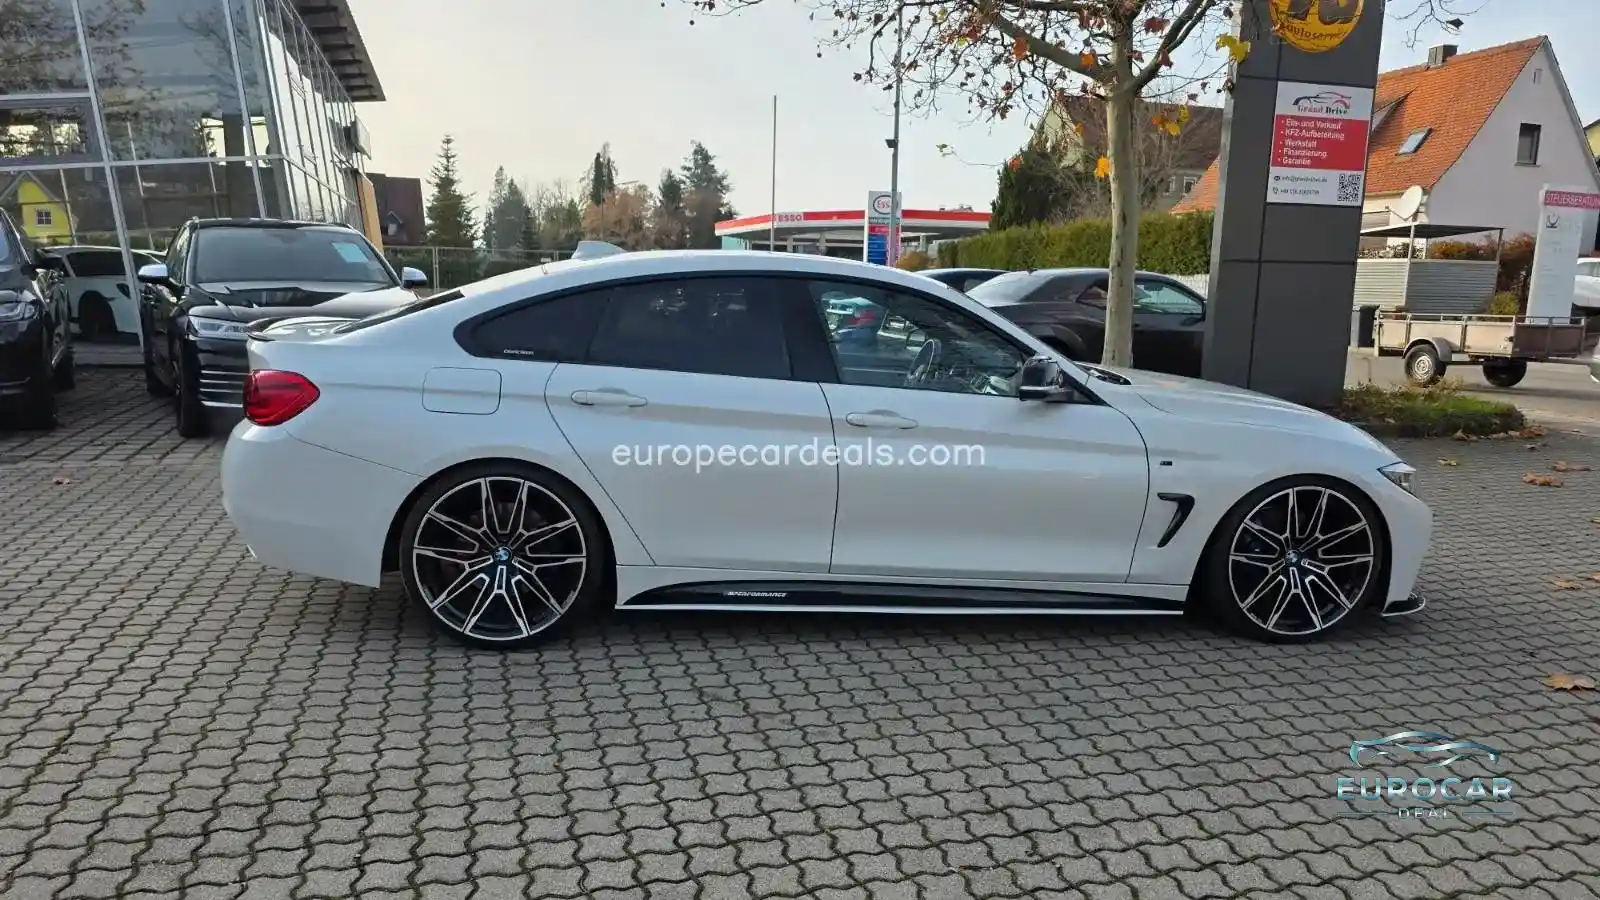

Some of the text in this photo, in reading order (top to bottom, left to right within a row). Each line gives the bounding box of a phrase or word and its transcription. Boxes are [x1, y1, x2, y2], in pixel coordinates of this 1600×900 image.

[1298, 105, 1348, 114] Grand Drive
[1316, 121, 1342, 130] Verkauf
[1285, 129, 1345, 140] KFZ-Aufbereitung
[1284, 140, 1317, 148] Werkstatt
[1283, 148, 1327, 158] Finanzierung
[1282, 157, 1311, 165] Garantie
[778, 213, 802, 222] ESSO
